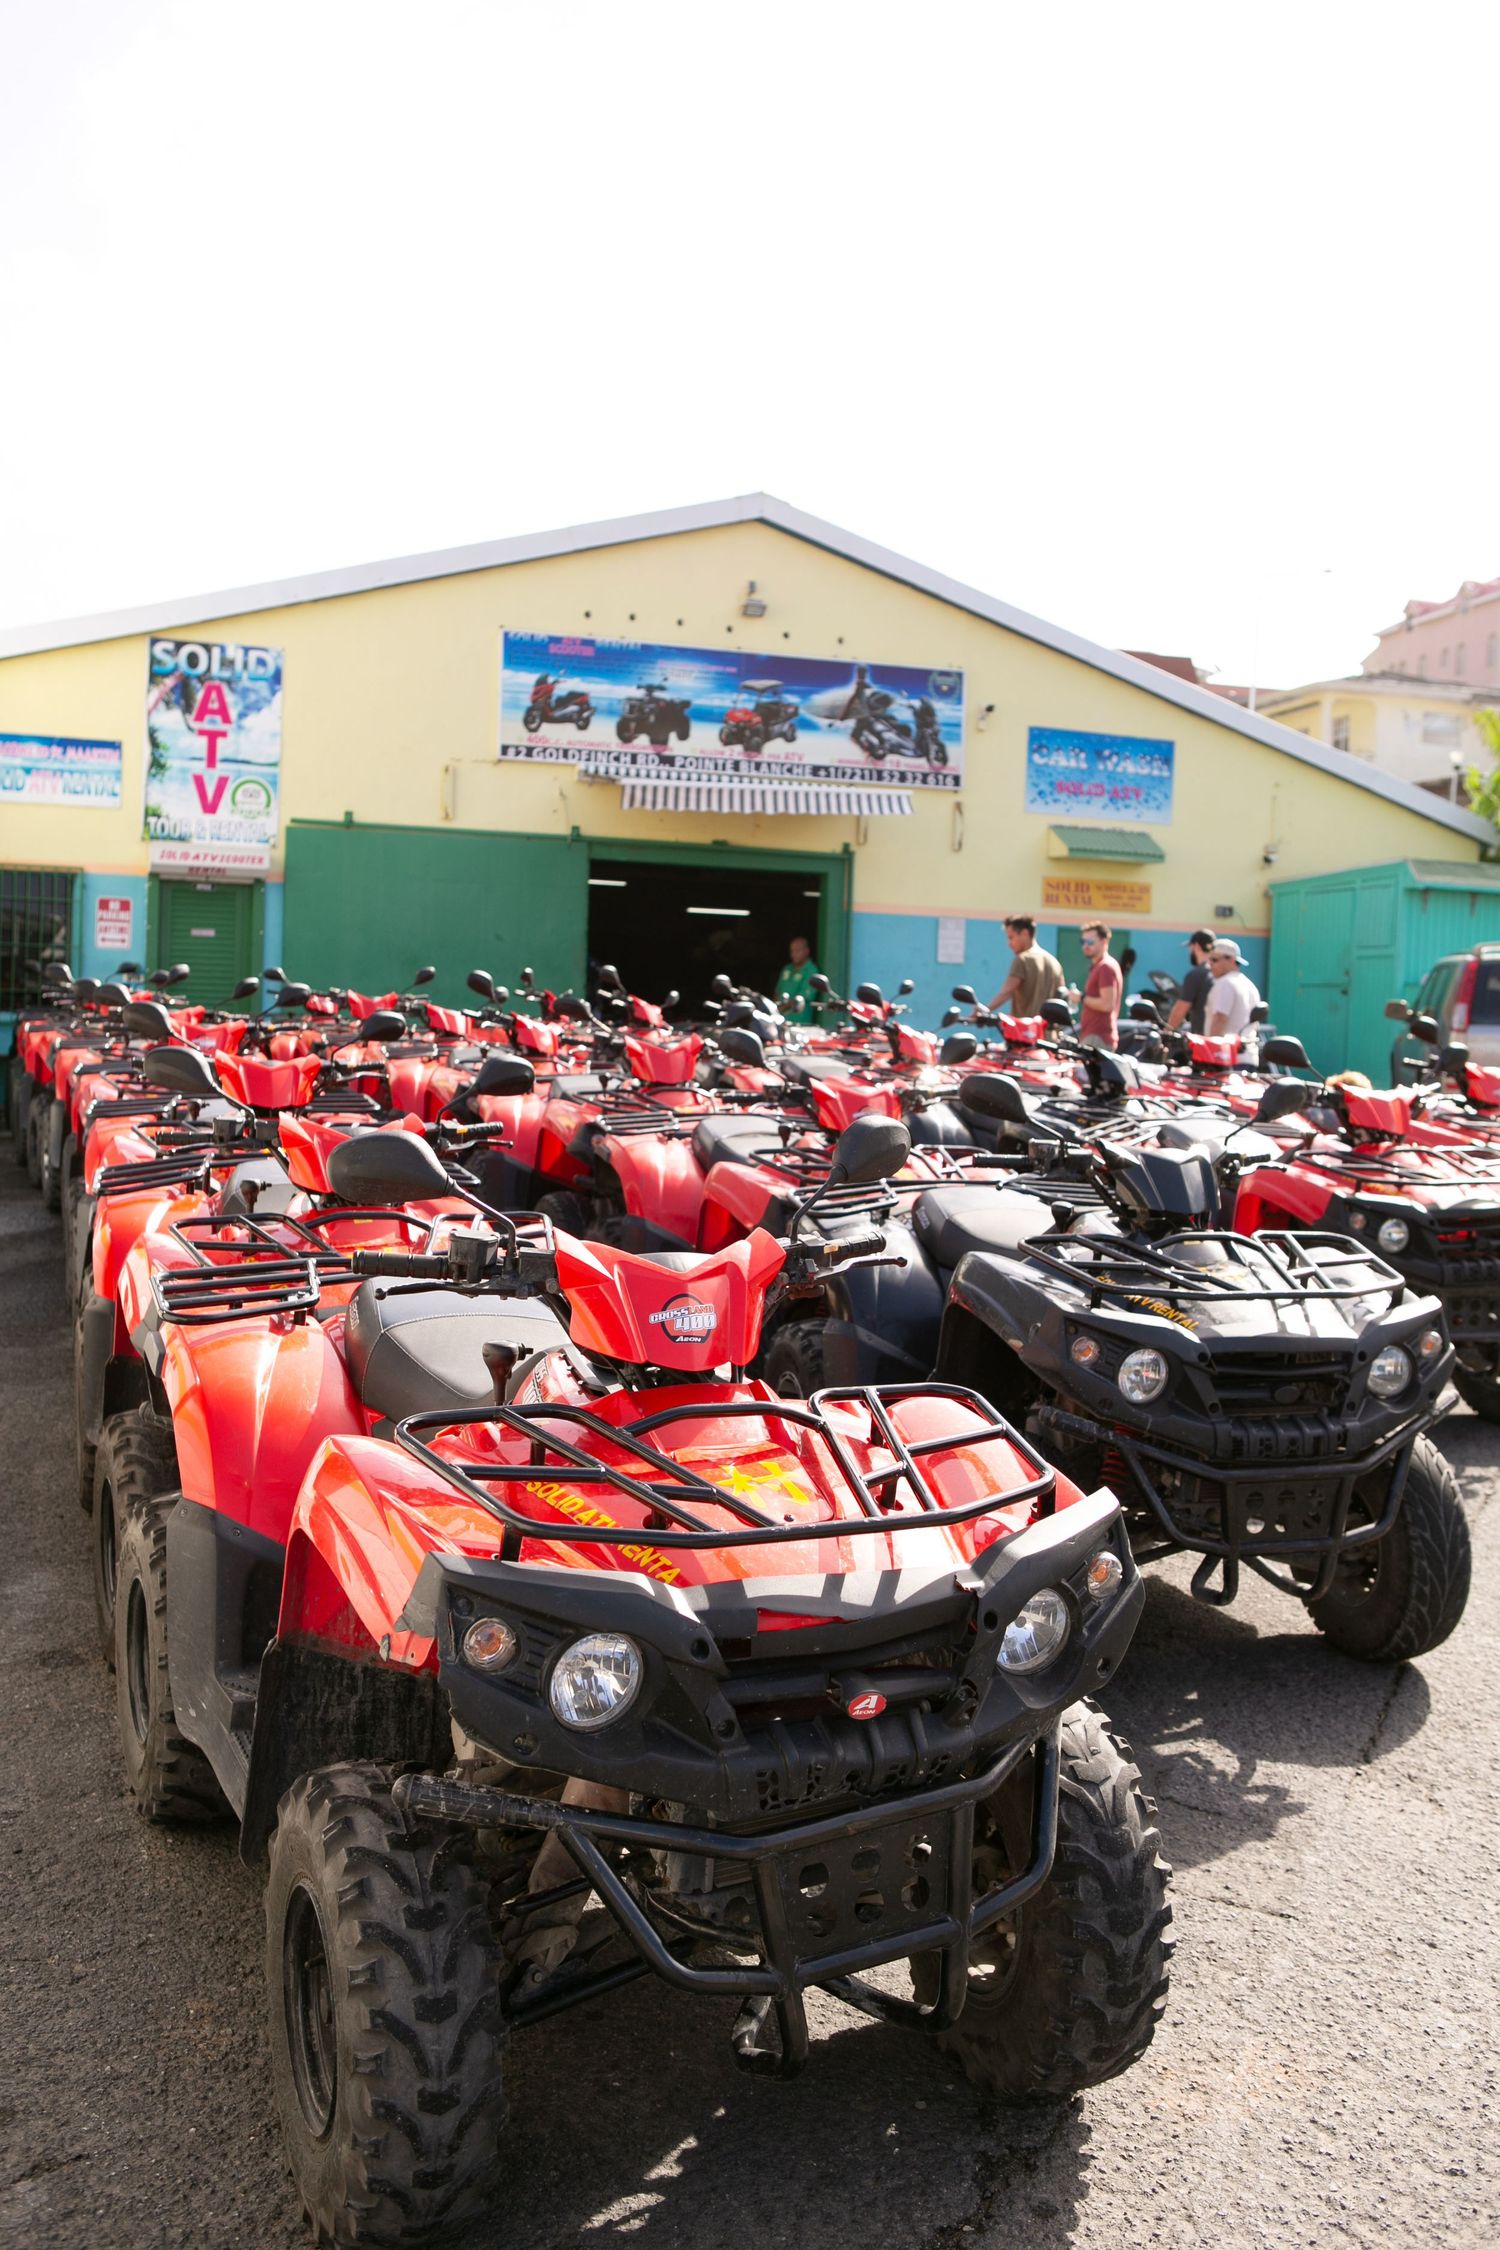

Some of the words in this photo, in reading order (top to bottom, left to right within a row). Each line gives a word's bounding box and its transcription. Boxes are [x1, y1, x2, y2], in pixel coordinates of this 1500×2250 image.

[151, 641, 276, 682] SOLID
[532, 747, 632, 764] GOLDFINCH
[675, 755, 735, 772] POINTE
[739, 759, 812, 778] BLANCHE
[882, 770, 899, 782] 52
[904, 772, 923, 784] 32
[926, 773, 955, 787] 616
[1032, 744, 1088, 769] CAR
[1096, 750, 1170, 777] WASH
[62, 770, 119, 797] RENTAL
[193, 851, 218, 863] ATV
[98, 910, 129, 921] PARKING
[649, 1303, 714, 1324] CROSSLAND
[674, 1313, 717, 1331] 400
[1148, 1302, 1199, 1331] RENTAL
[526, 1481, 585, 1515] SOLID
